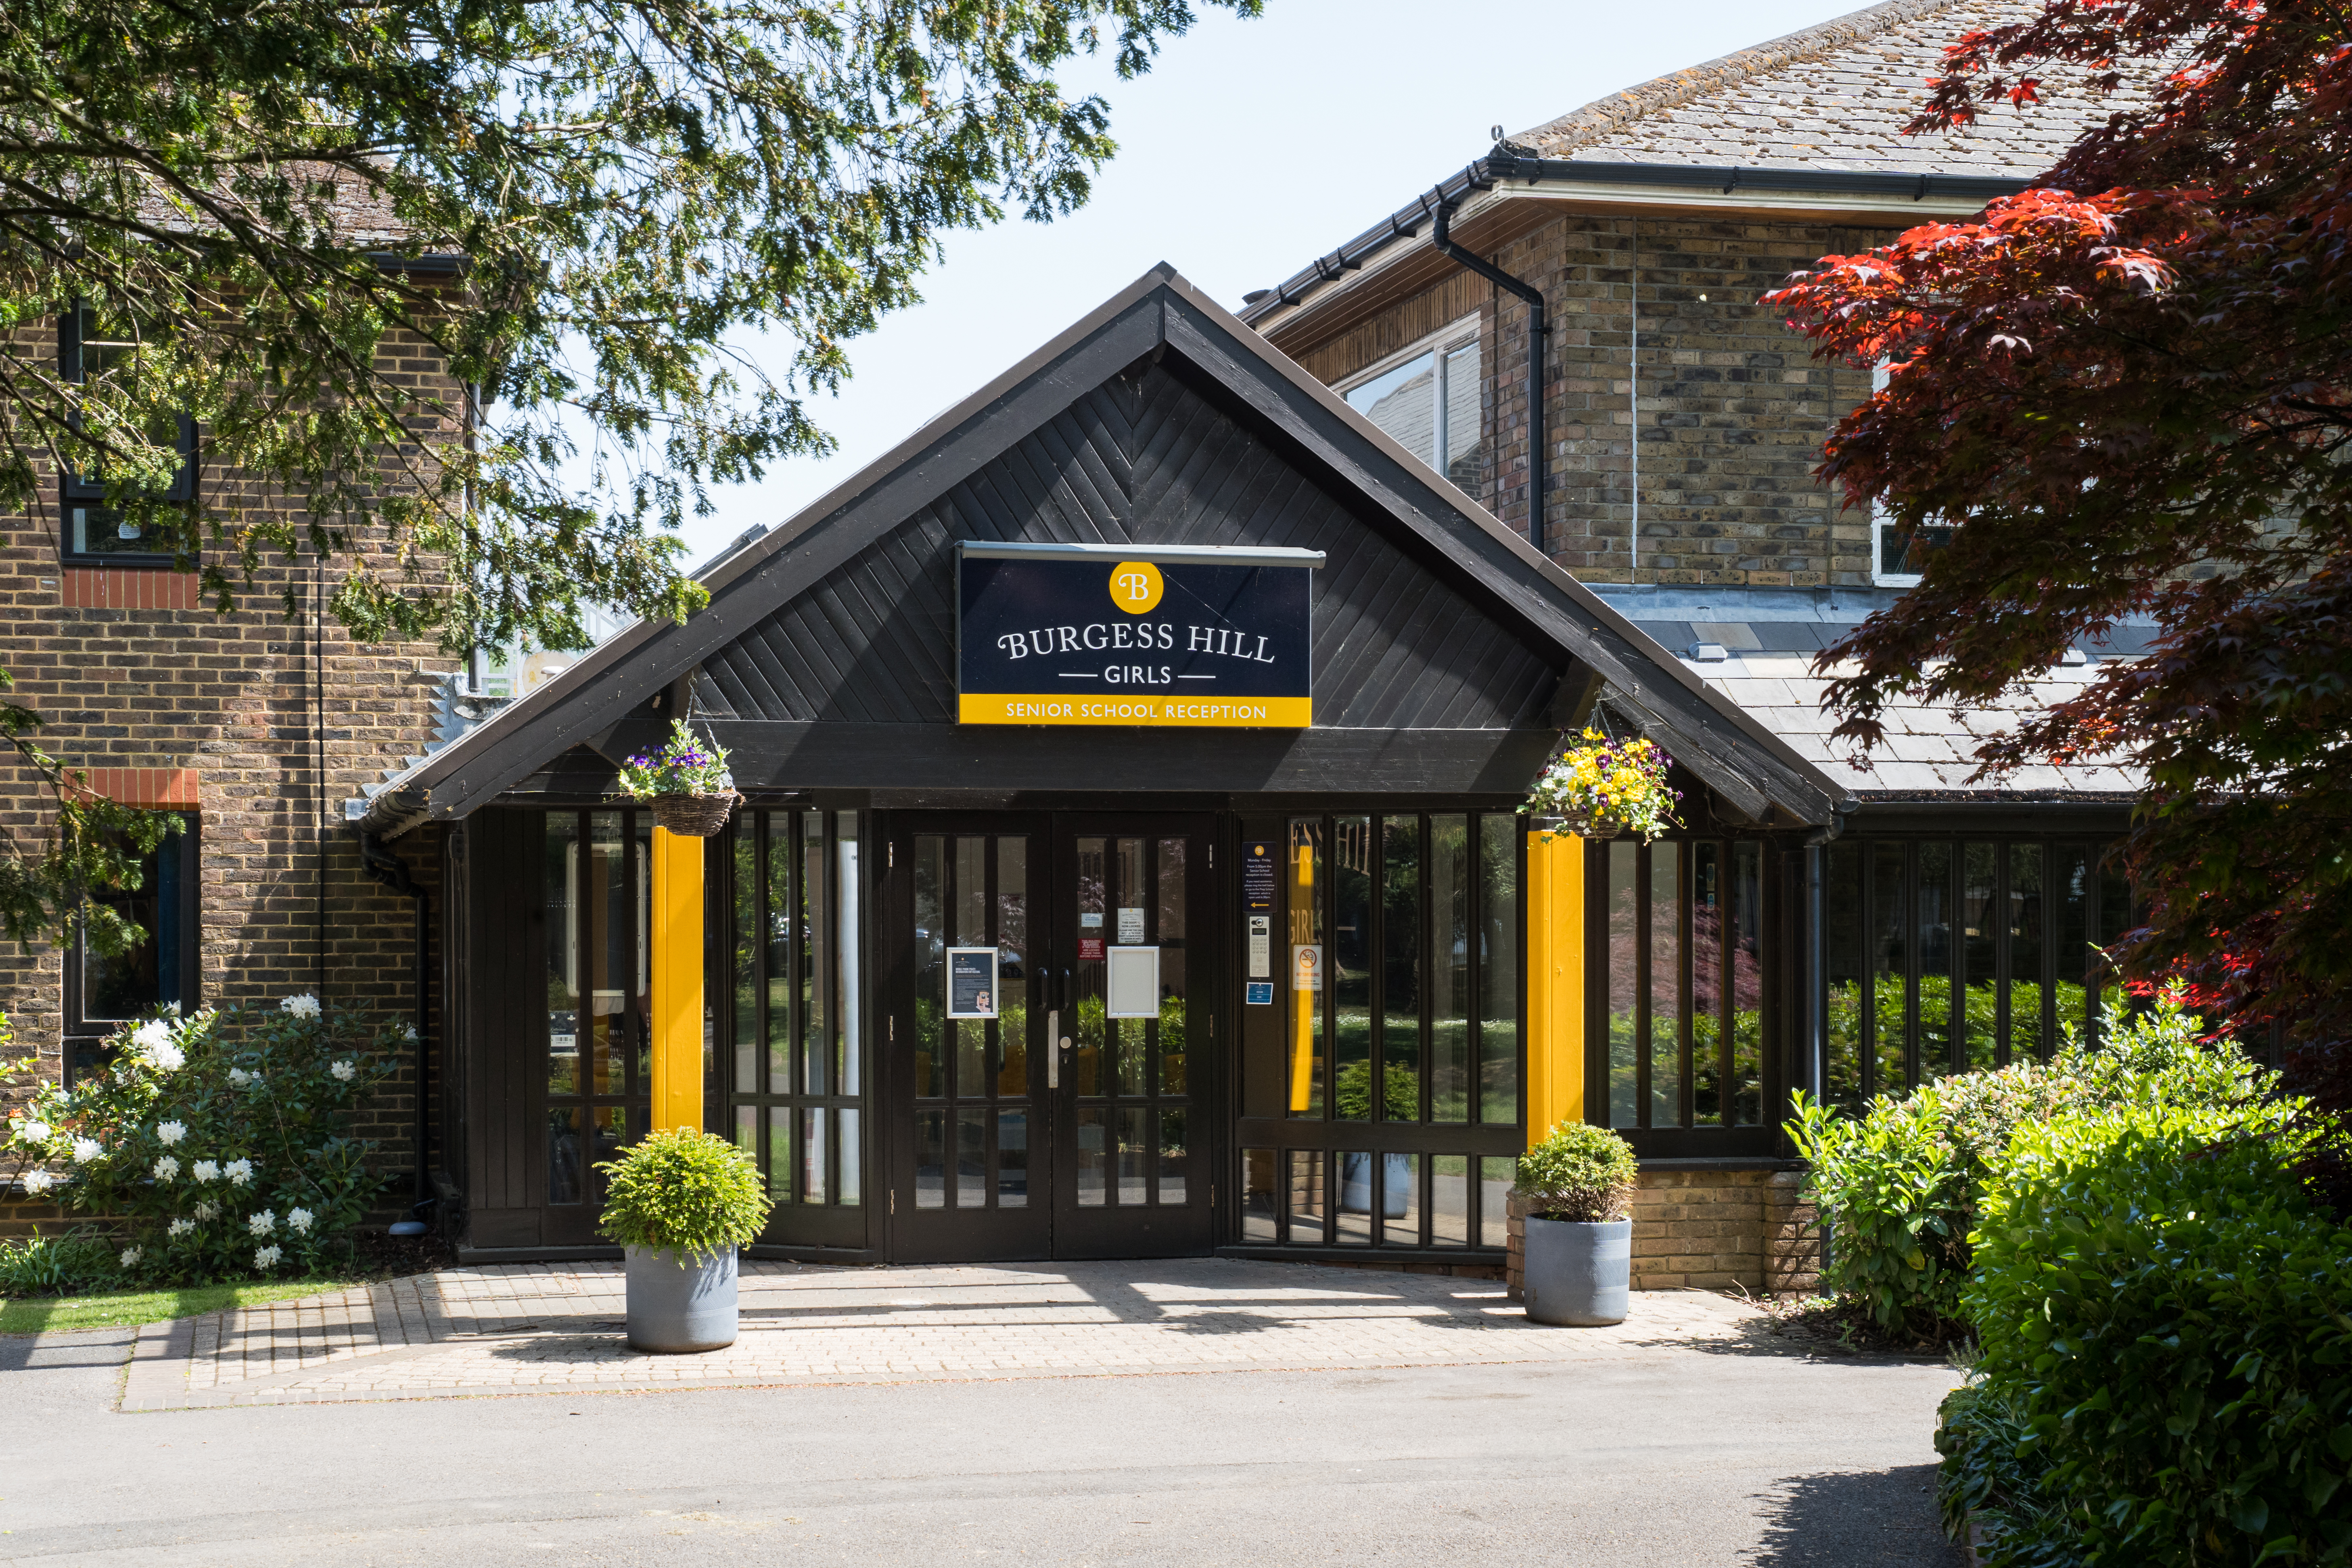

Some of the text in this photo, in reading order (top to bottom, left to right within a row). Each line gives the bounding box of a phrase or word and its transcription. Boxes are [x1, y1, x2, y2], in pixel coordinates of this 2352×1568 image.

[1119, 574, 1149, 600] B
[997, 623, 1275, 663] BURGESS HILL
[1104, 665, 1171, 684] GIRLS
[1006, 703, 1266, 719] SENIOR SCHOOL RECEPTION
